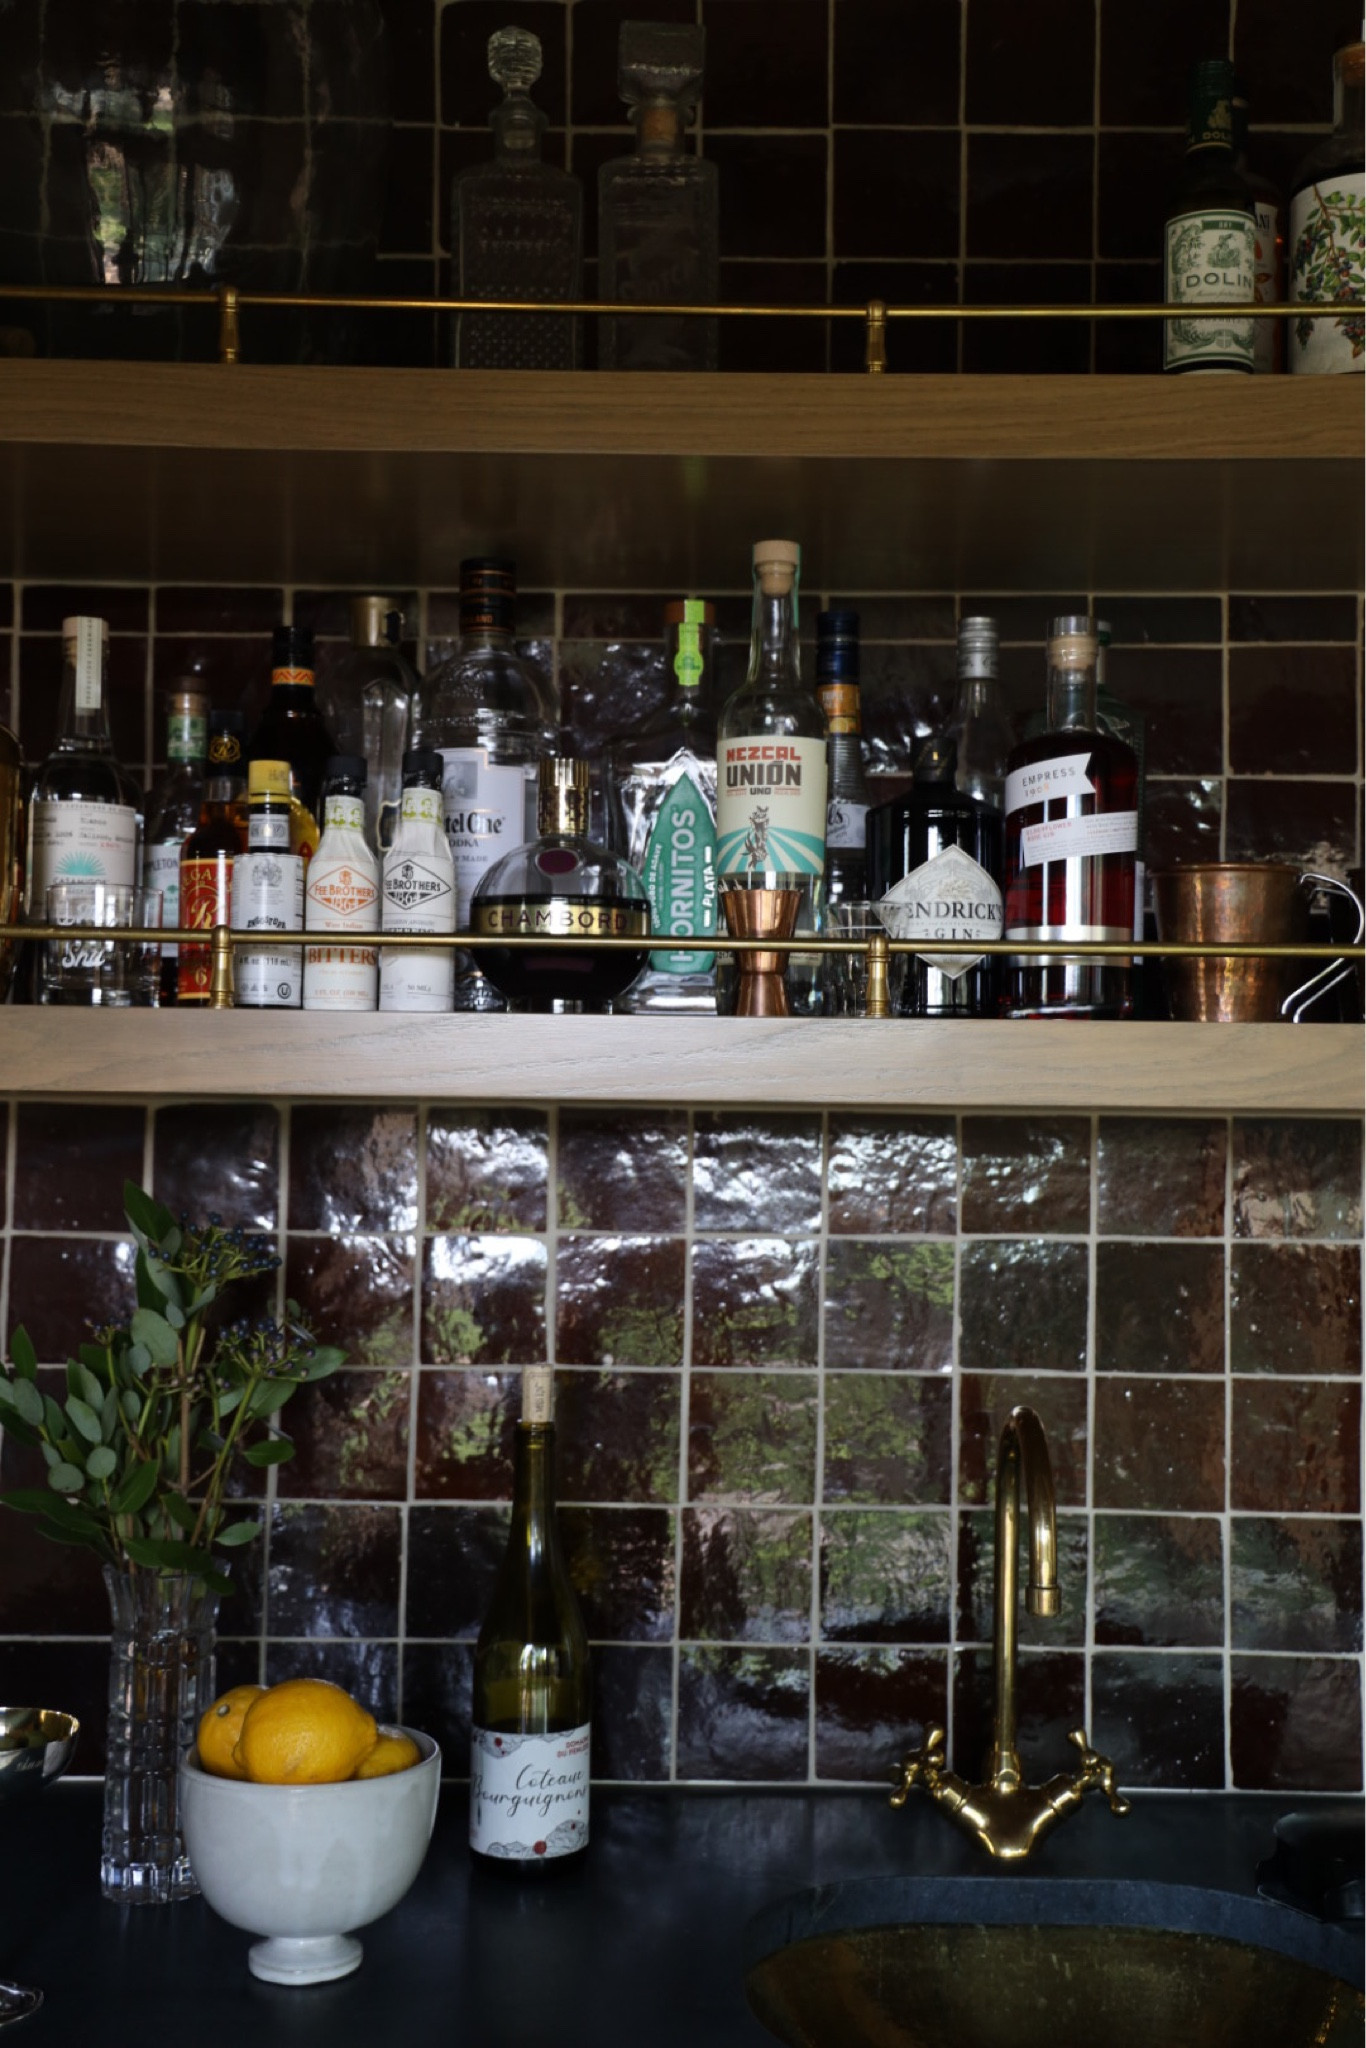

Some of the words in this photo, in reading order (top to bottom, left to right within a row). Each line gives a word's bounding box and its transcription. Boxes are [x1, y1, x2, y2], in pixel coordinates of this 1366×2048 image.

[1186, 272, 1252, 288] DOLIN
[726, 746, 802, 762] MEZCAL
[1022, 766, 1076, 787] EMPRESS
[750, 787, 772, 796] UNO
[444, 813, 465, 833] tel
[467, 812, 503, 834] One
[449, 838, 479, 848] ODKA
[314, 884, 328, 896] FEE
[329, 884, 375, 898] BROTHERS
[393, 878, 441, 892] BROTHERS
[670, 808, 696, 962] HORNITOS
[702, 865, 715, 909] PLATA
[488, 910, 627, 930] CHAMBORD
[905, 902, 1003, 921] ENDRICK'S
[934, 927, 973, 939] GIN
[308, 948, 376, 966] BITTERS
